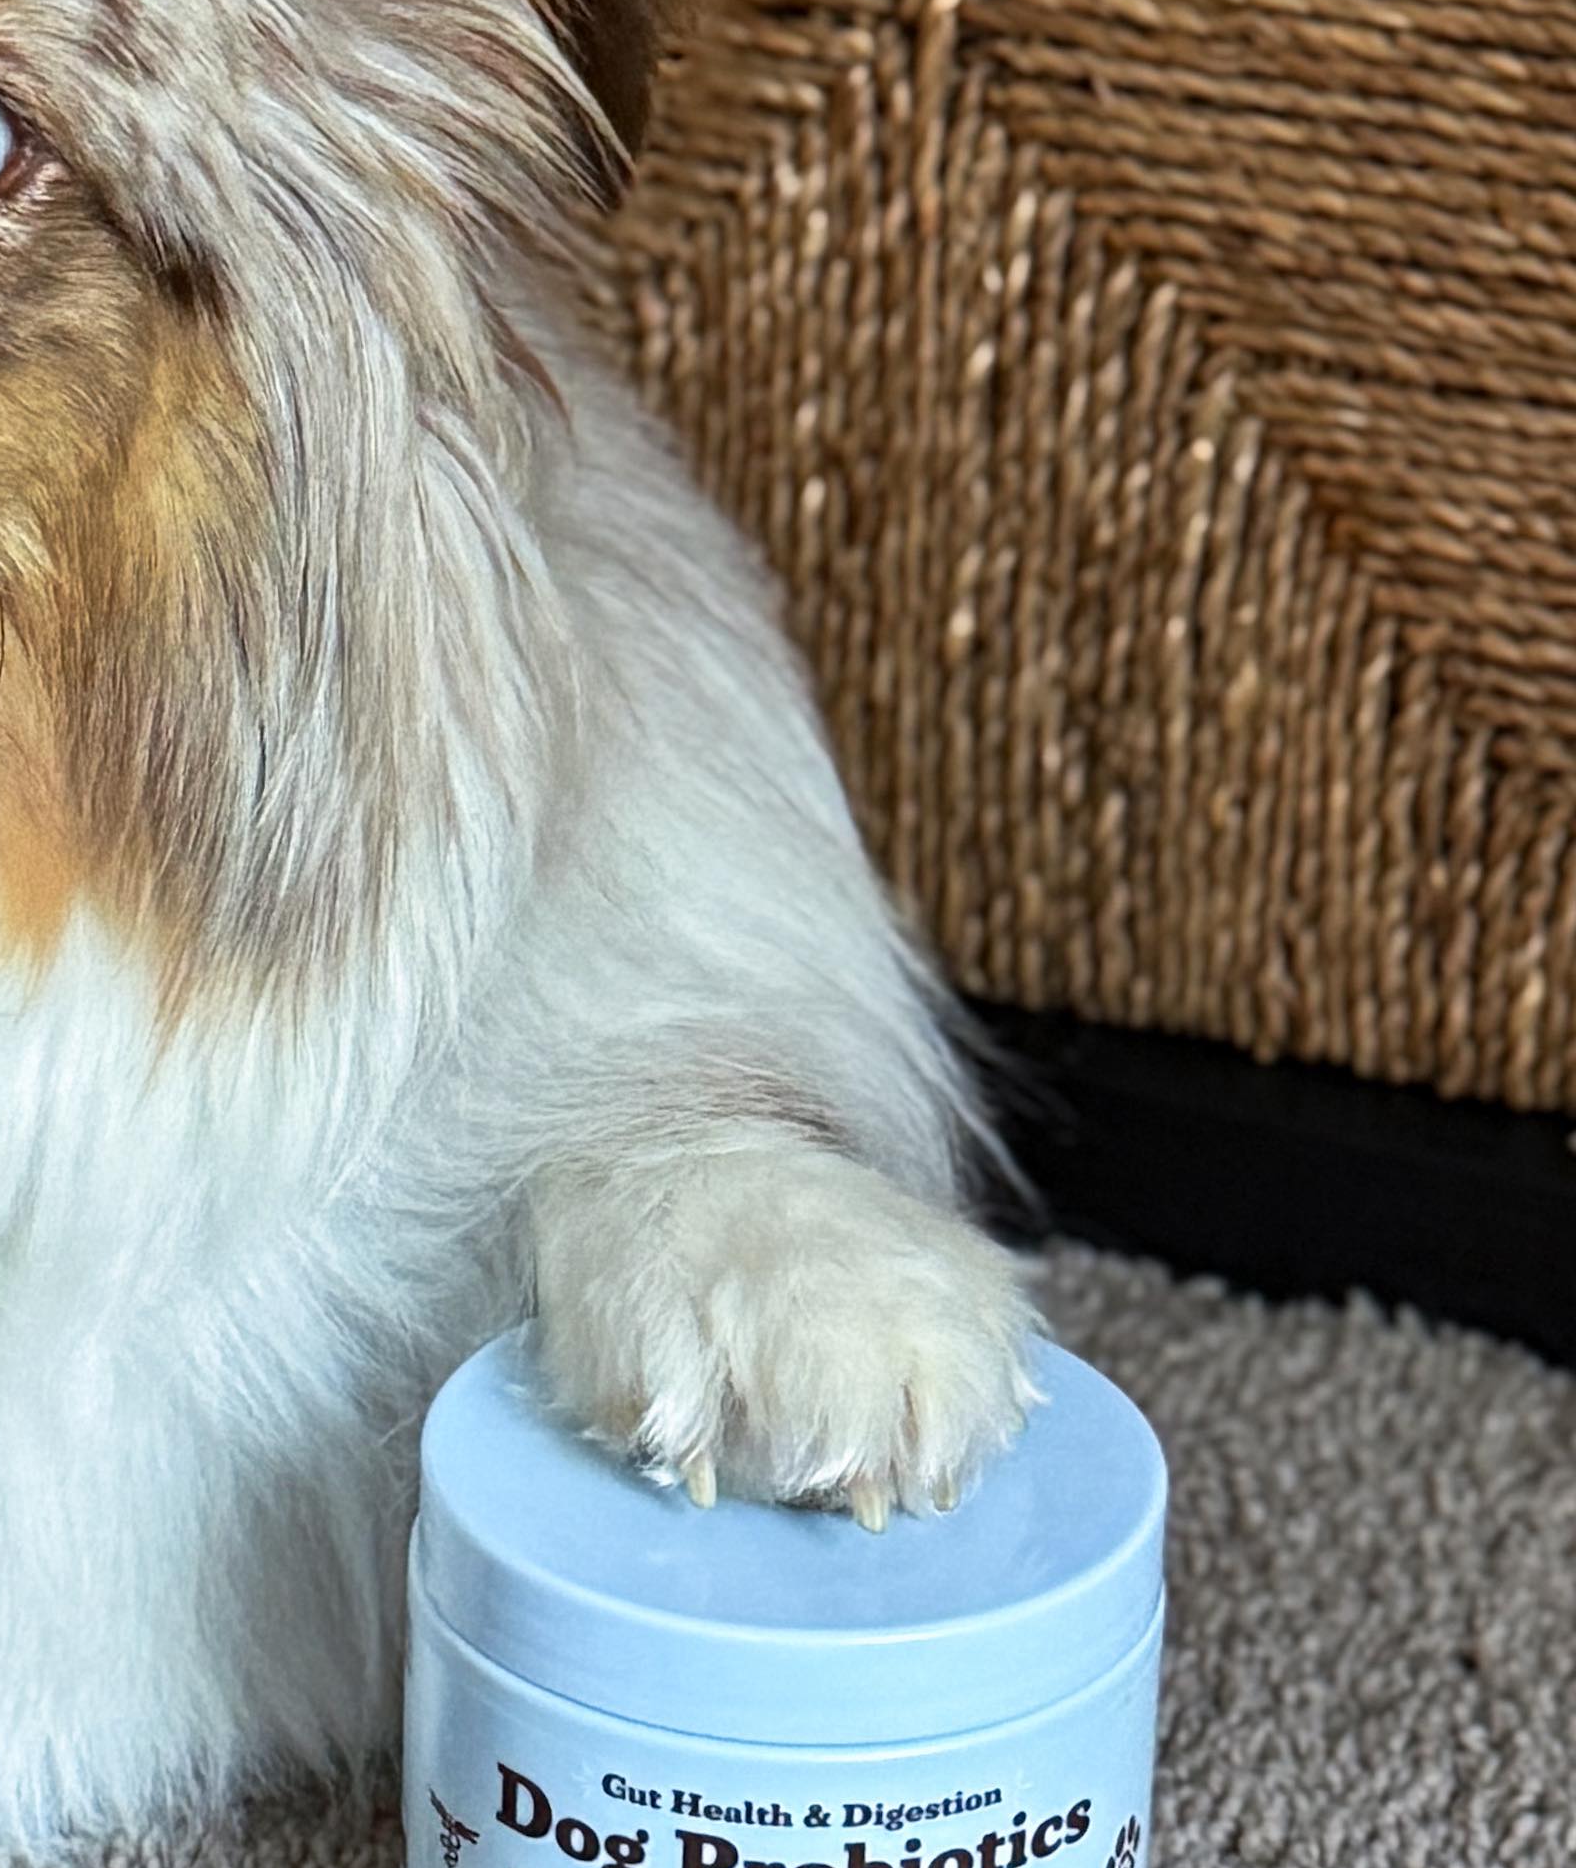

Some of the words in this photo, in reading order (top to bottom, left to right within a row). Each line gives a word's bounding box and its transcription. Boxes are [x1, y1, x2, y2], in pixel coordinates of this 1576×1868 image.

[601, 1772, 663, 1810] Gut
[670, 1789, 794, 1828] Health
[803, 1804, 832, 1828] &
[841, 1787, 1003, 1831] Digestion
